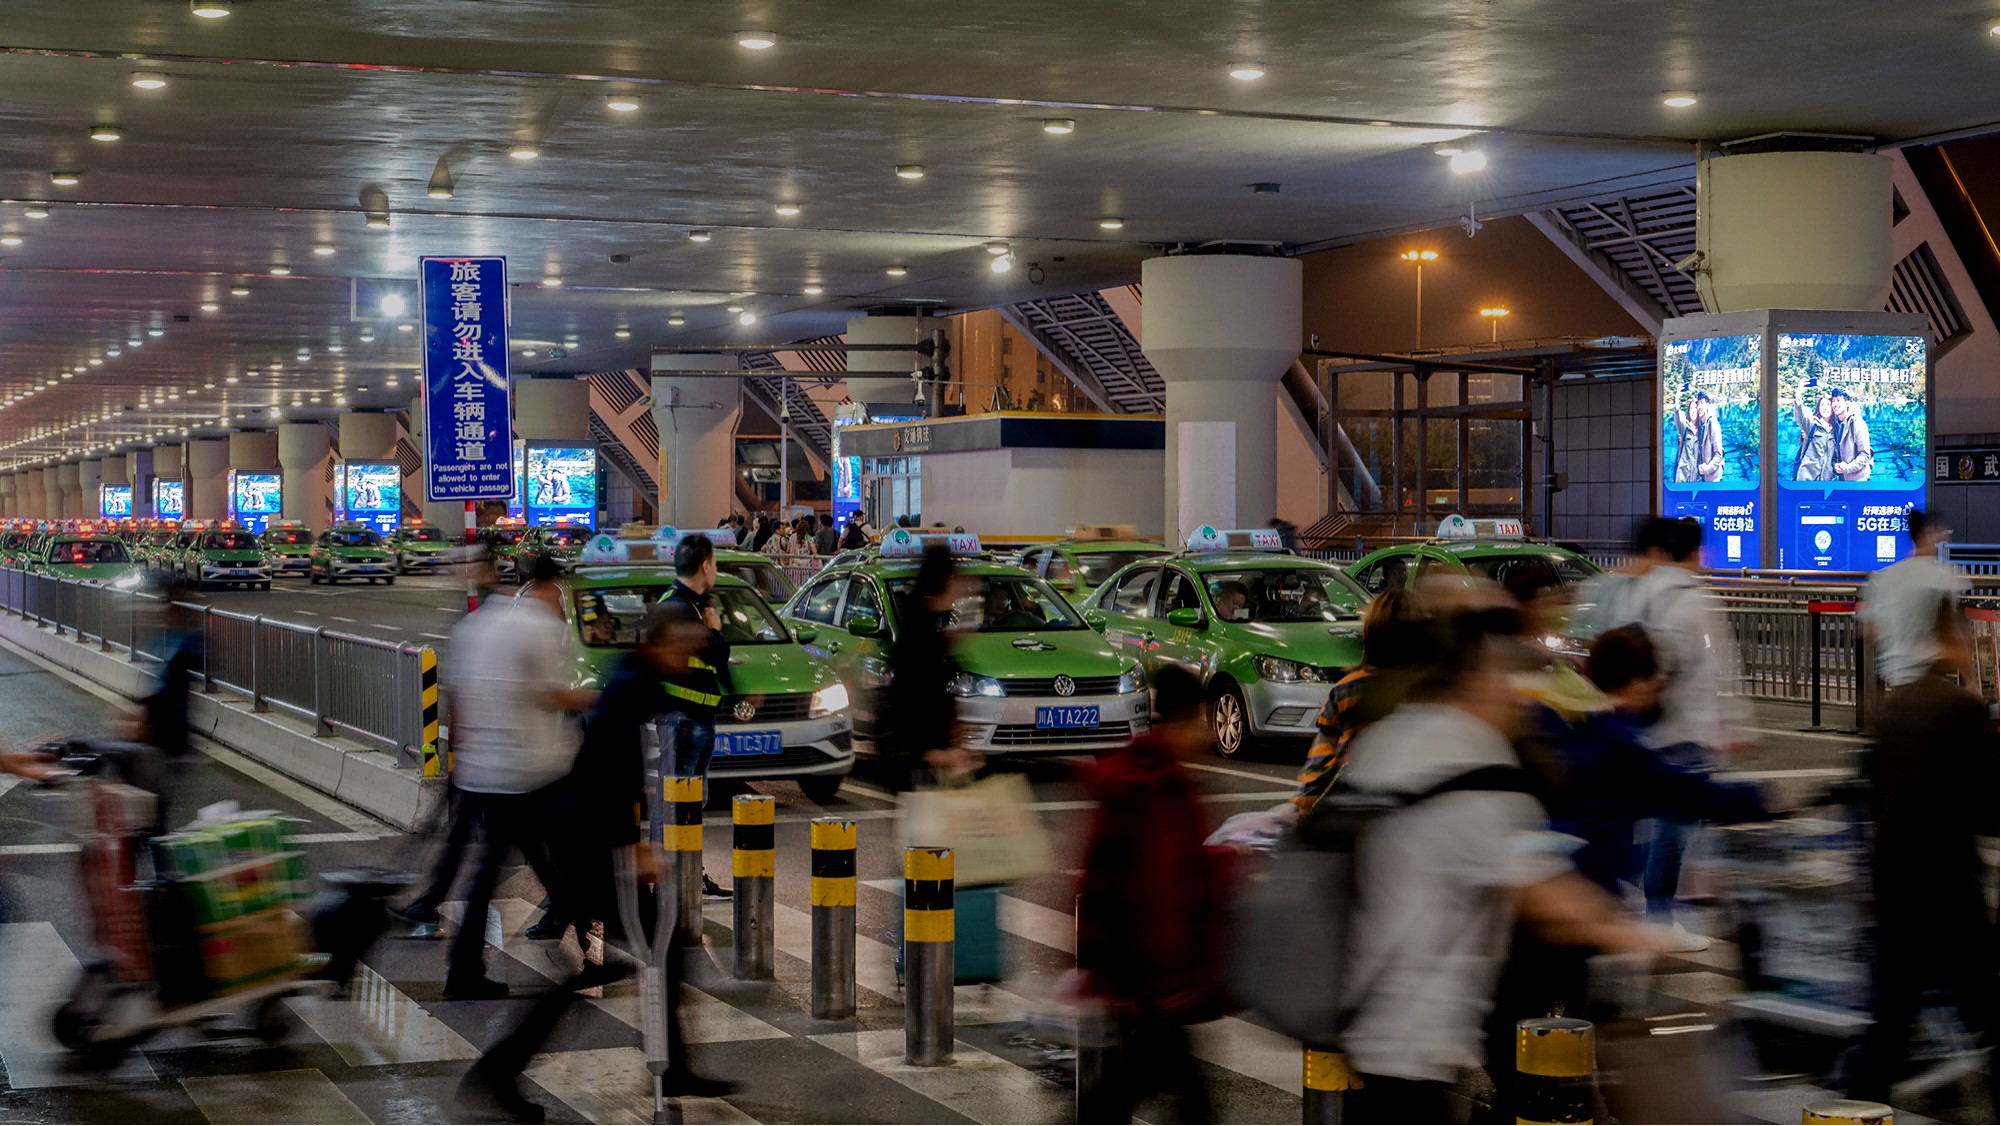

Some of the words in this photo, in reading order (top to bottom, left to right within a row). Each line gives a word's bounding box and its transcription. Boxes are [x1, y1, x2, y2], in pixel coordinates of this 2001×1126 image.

[449, 262, 486, 461] 旅客请勿进入车辆通道
[433, 463, 476, 473] Passengers
[496, 462, 508, 470] not
[1935, 456, 1949, 478] 国
[1984, 454, 1999, 477] 武
[438, 473, 466, 483] allowed
[481, 473, 500, 481] enter
[434, 485, 446, 493] the
[450, 484, 475, 493] vehicle
[479, 484, 509, 493] passage
[1499, 523, 1520, 535] TAXI
[1713, 517, 1754, 532] 5G在身边
[952, 538, 977, 551] TAXI
[1255, 534, 1279, 546] TAXI
